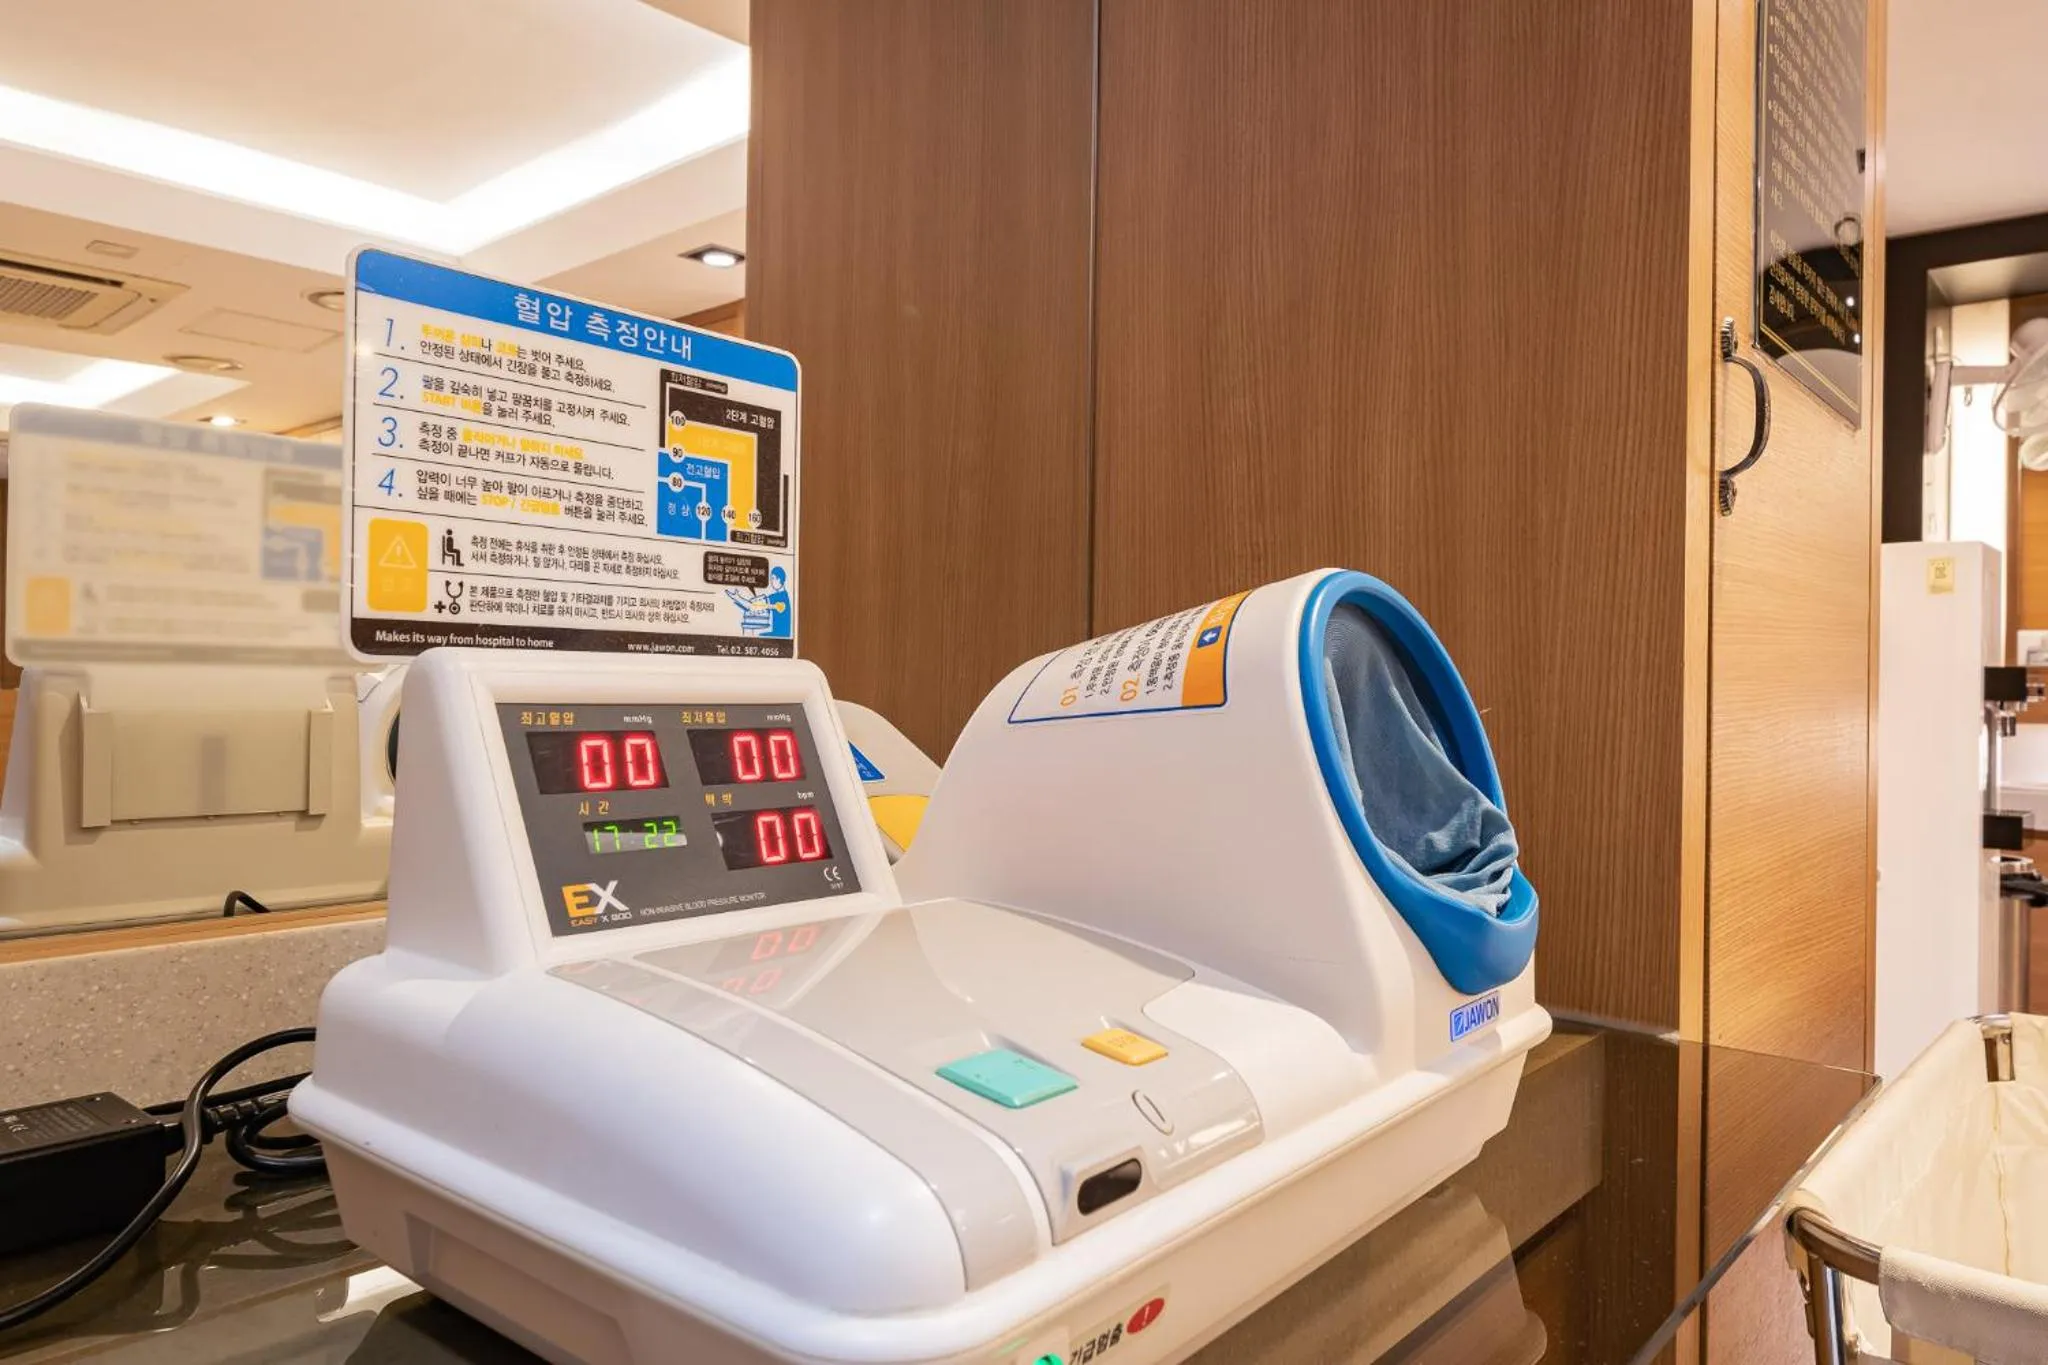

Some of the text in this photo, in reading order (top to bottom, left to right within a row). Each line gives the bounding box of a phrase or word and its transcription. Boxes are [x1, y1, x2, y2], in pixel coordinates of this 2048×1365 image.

[514, 293, 693, 361] 혈압 측정안내
[386, 318, 405, 351] 1.
[531, 349, 551, 364] 벗어
[420, 340, 455, 360] 안정된
[459, 348, 502, 369] 상태에서
[507, 359, 537, 377] 긴장을
[565, 371, 615, 393] 측정하세요.
[378, 367, 404, 399] 2.
[497, 404, 518, 421] 눌러
[512, 392, 552, 412] 팔꿈치를
[557, 401, 595, 420] 고정시켜
[419, 421, 442, 439] 측정
[447, 426, 457, 441] 중
[671, 414, 686, 427] 100
[725, 408, 775, 430] 2단계 고혈압
[378, 416, 403, 449] 3.
[419, 438, 453, 456] 측정이
[458, 444, 490, 462] 끝나면
[495, 450, 526, 467] 커프가
[530, 455, 570, 473] 자동으로
[672, 447, 683, 459] 90
[377, 468, 403, 498] 4.
[671, 476, 682, 488] 80
[686, 463, 721, 480] 전고혈압
[416, 469, 451, 487] 압력이
[456, 475, 478, 489] 너무
[482, 479, 503, 493] 높아
[531, 485, 571, 502] 아프거나
[576, 490, 603, 507] 측정을
[607, 495, 643, 511] 중단하고
[417, 486, 439, 501] 싶을
[444, 489, 477, 506] 때에는
[564, 505, 592, 519] 버튼을
[597, 509, 615, 522] 눌러
[697, 506, 762, 524] 120 140 160
[569, 559, 590, 573] 다리를
[481, 586, 514, 599] 제품으로
[375, 629, 554, 649] Makes its way from hospital to home
[627, 642, 695, 655] www.jawon.com
[521, 711, 652, 727] 최고혈압 mmHg
[580, 738, 656, 789] 00
[733, 735, 797, 780] 00
[797, 790, 816, 800] bpm
[757, 812, 821, 864] 00
[823, 865, 842, 882] CE
[562, 880, 630, 918] EX
[1465, 995, 1500, 1032] JAWON
